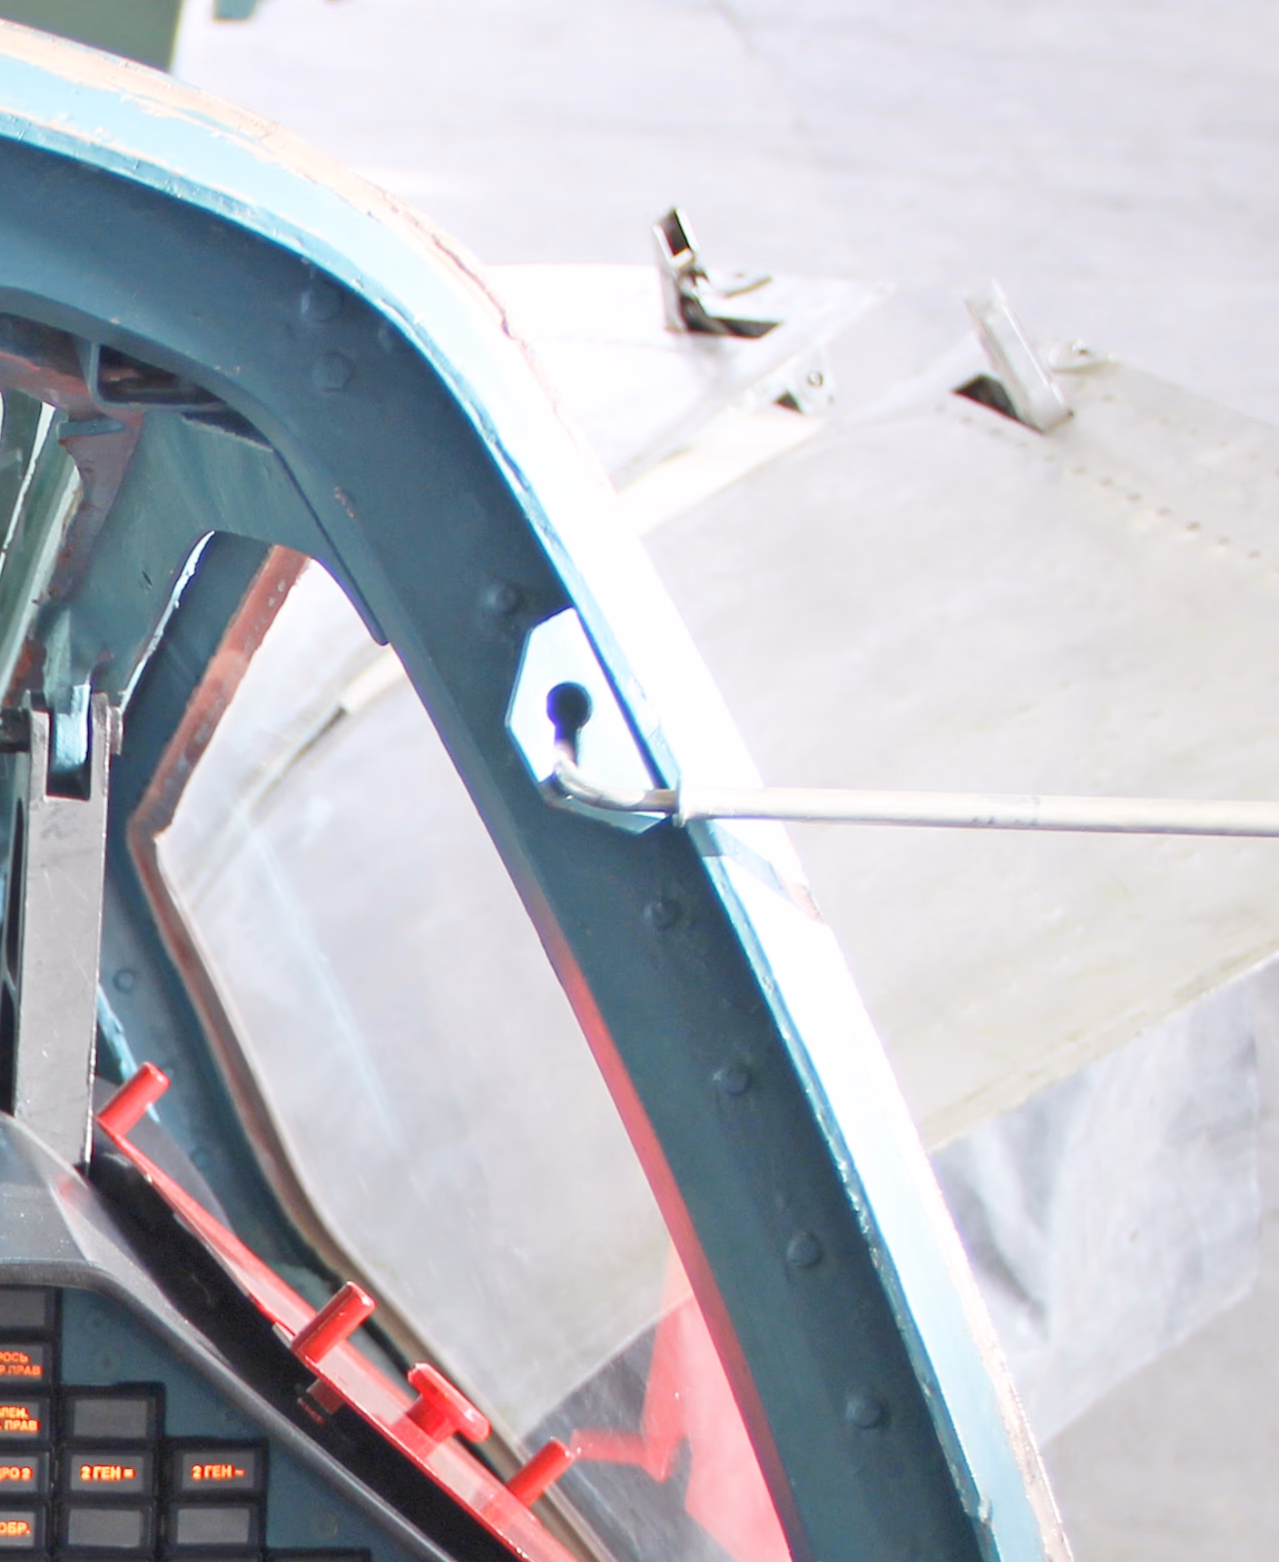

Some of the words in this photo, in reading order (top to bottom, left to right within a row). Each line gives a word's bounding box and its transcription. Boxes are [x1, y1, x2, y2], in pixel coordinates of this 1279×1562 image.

[8, 1364, 43, 1377] ПРАВ
[4, 1419, 40, 1433] ПРАВ
[93, 1465, 120, 1480] ГЕН
[203, 1464, 232, 1480] ГЕН
